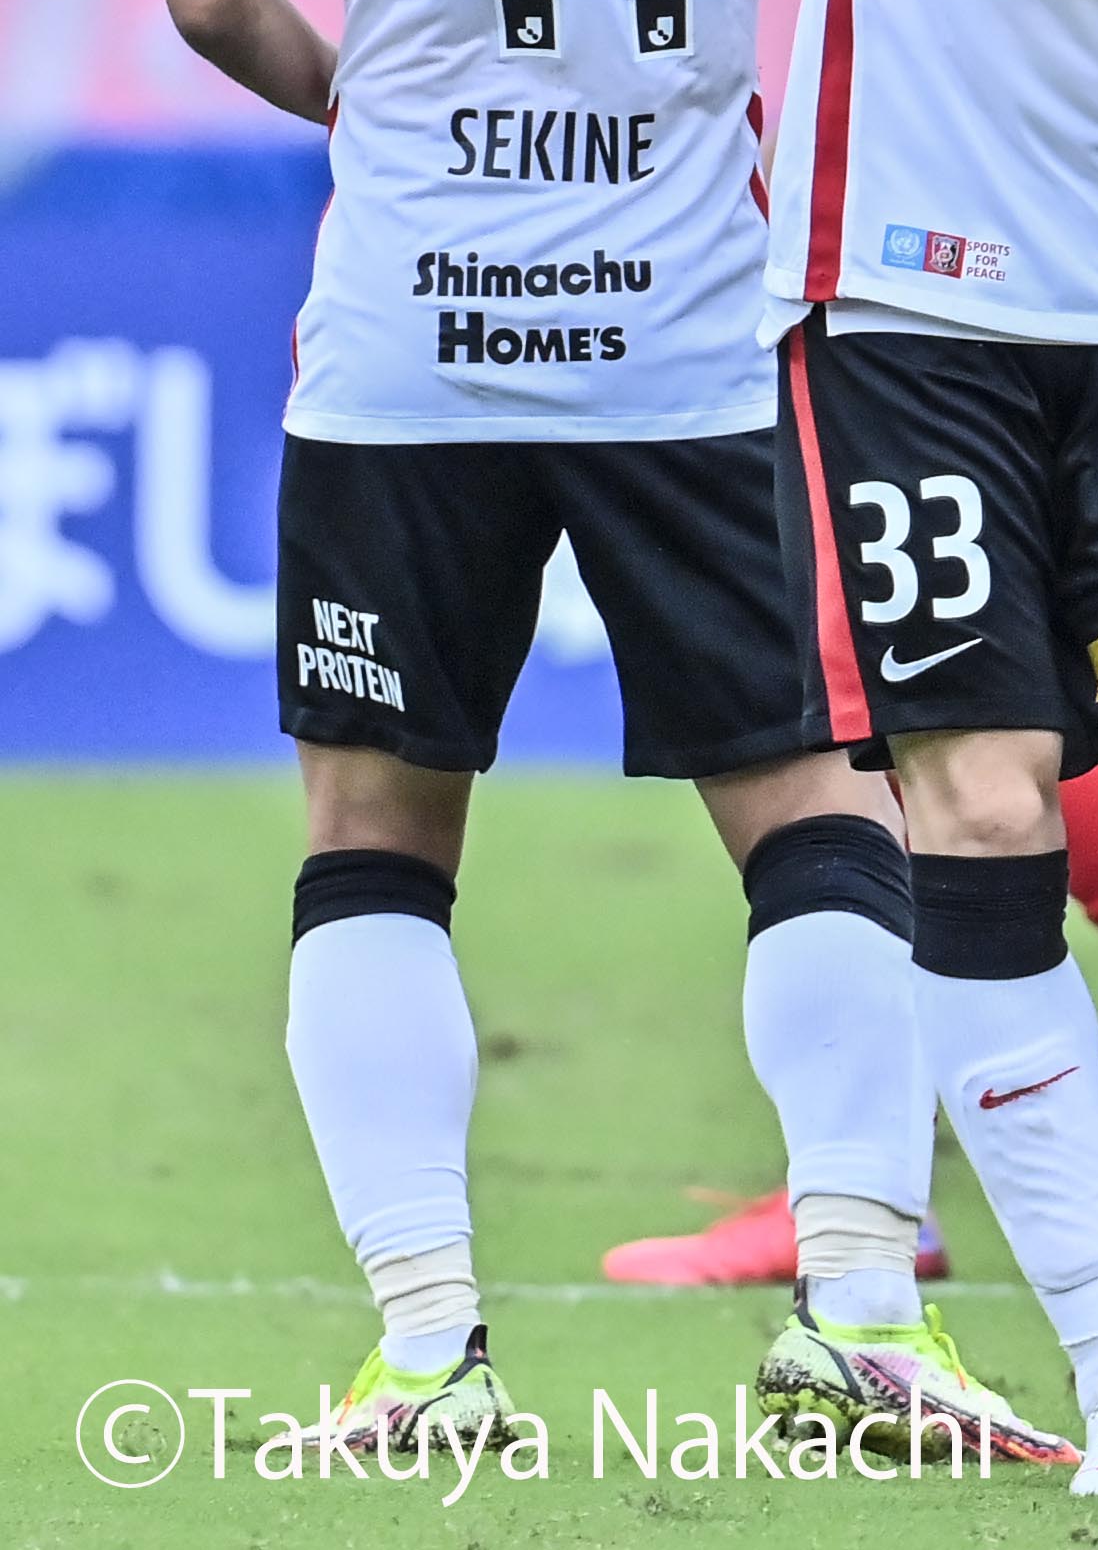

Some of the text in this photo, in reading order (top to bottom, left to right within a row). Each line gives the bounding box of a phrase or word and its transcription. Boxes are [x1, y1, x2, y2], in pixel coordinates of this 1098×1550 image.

[447, 107, 656, 185] SEKINE
[412, 250, 652, 297] Shimachu
[966, 241, 1011, 257] SPORTS
[966, 266, 1006, 282] PEACE!
[975, 254, 998, 267] FOR
[437, 311, 626, 364] HOME'S
[849, 474, 992, 623] 33
[312, 598, 379, 656] NEXT
[297, 643, 405, 712] PROTEIN
